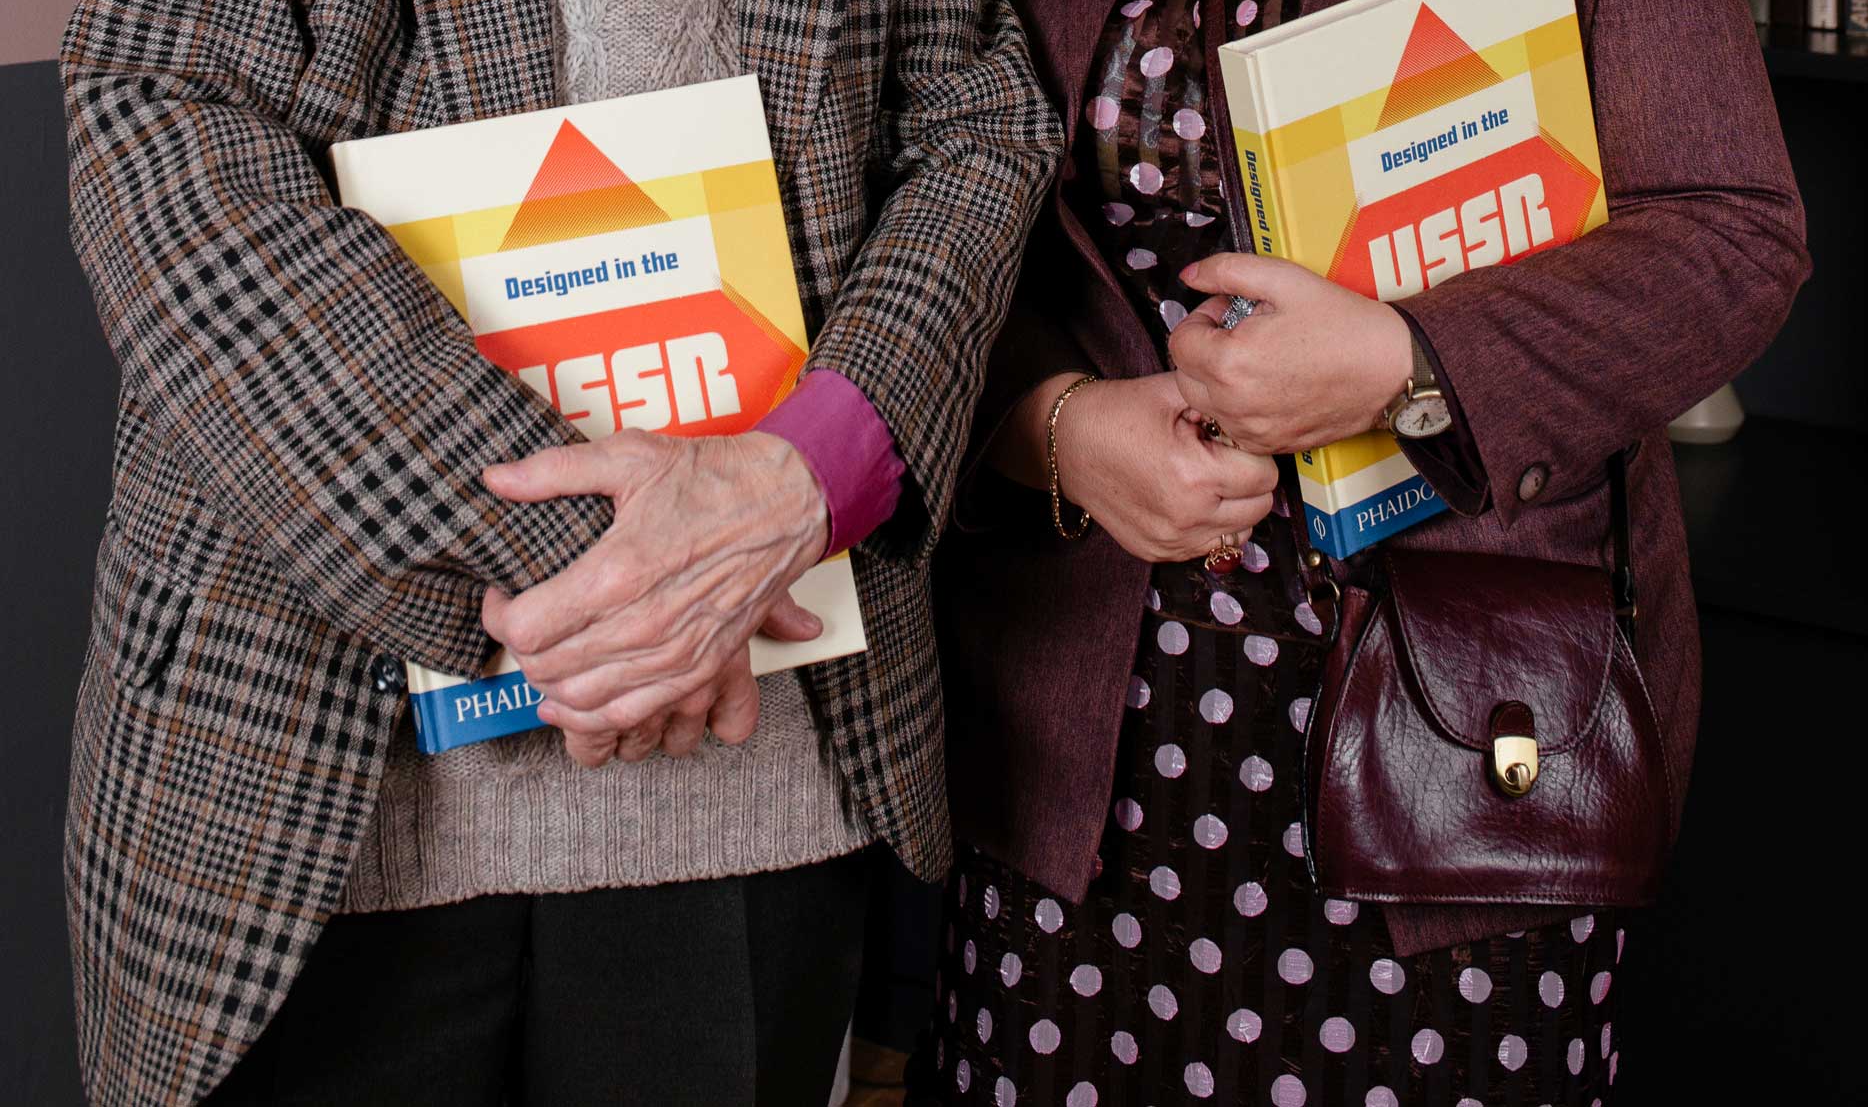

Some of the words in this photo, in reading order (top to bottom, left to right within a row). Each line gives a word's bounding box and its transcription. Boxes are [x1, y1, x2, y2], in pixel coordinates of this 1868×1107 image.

[1381, 125, 1458, 173] Designed
[1461, 121, 1478, 140] in
[1481, 109, 1509, 132] the
[1245, 149, 1270, 232] Designed
[1261, 235, 1272, 253] in
[1368, 173, 1555, 302] USSR
[505, 261, 609, 300] Designed
[614, 258, 636, 280] in
[641, 251, 679, 274] the
[510, 332, 741, 442] SSR
